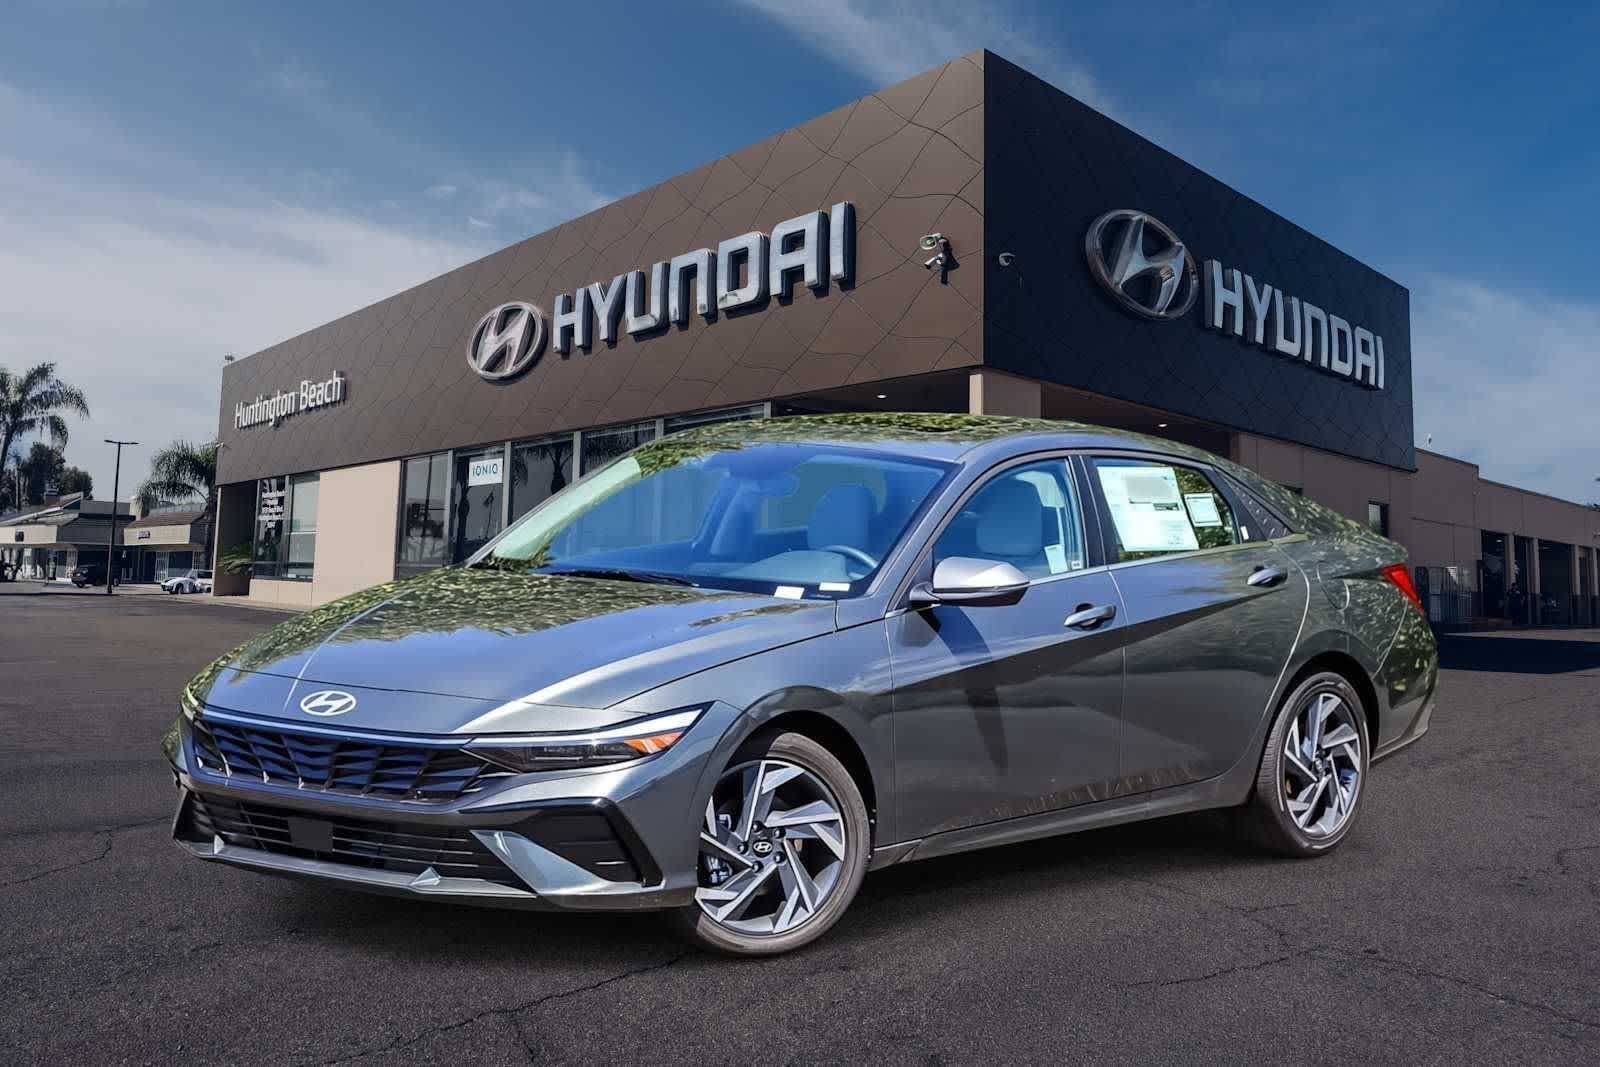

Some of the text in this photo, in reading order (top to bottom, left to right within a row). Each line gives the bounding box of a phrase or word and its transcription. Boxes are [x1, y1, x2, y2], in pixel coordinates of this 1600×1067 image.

[552, 201, 852, 353] HYUNDAI
[1206, 258, 1385, 390] HYUNDAI
[234, 370, 342, 429] Huntington Beach
